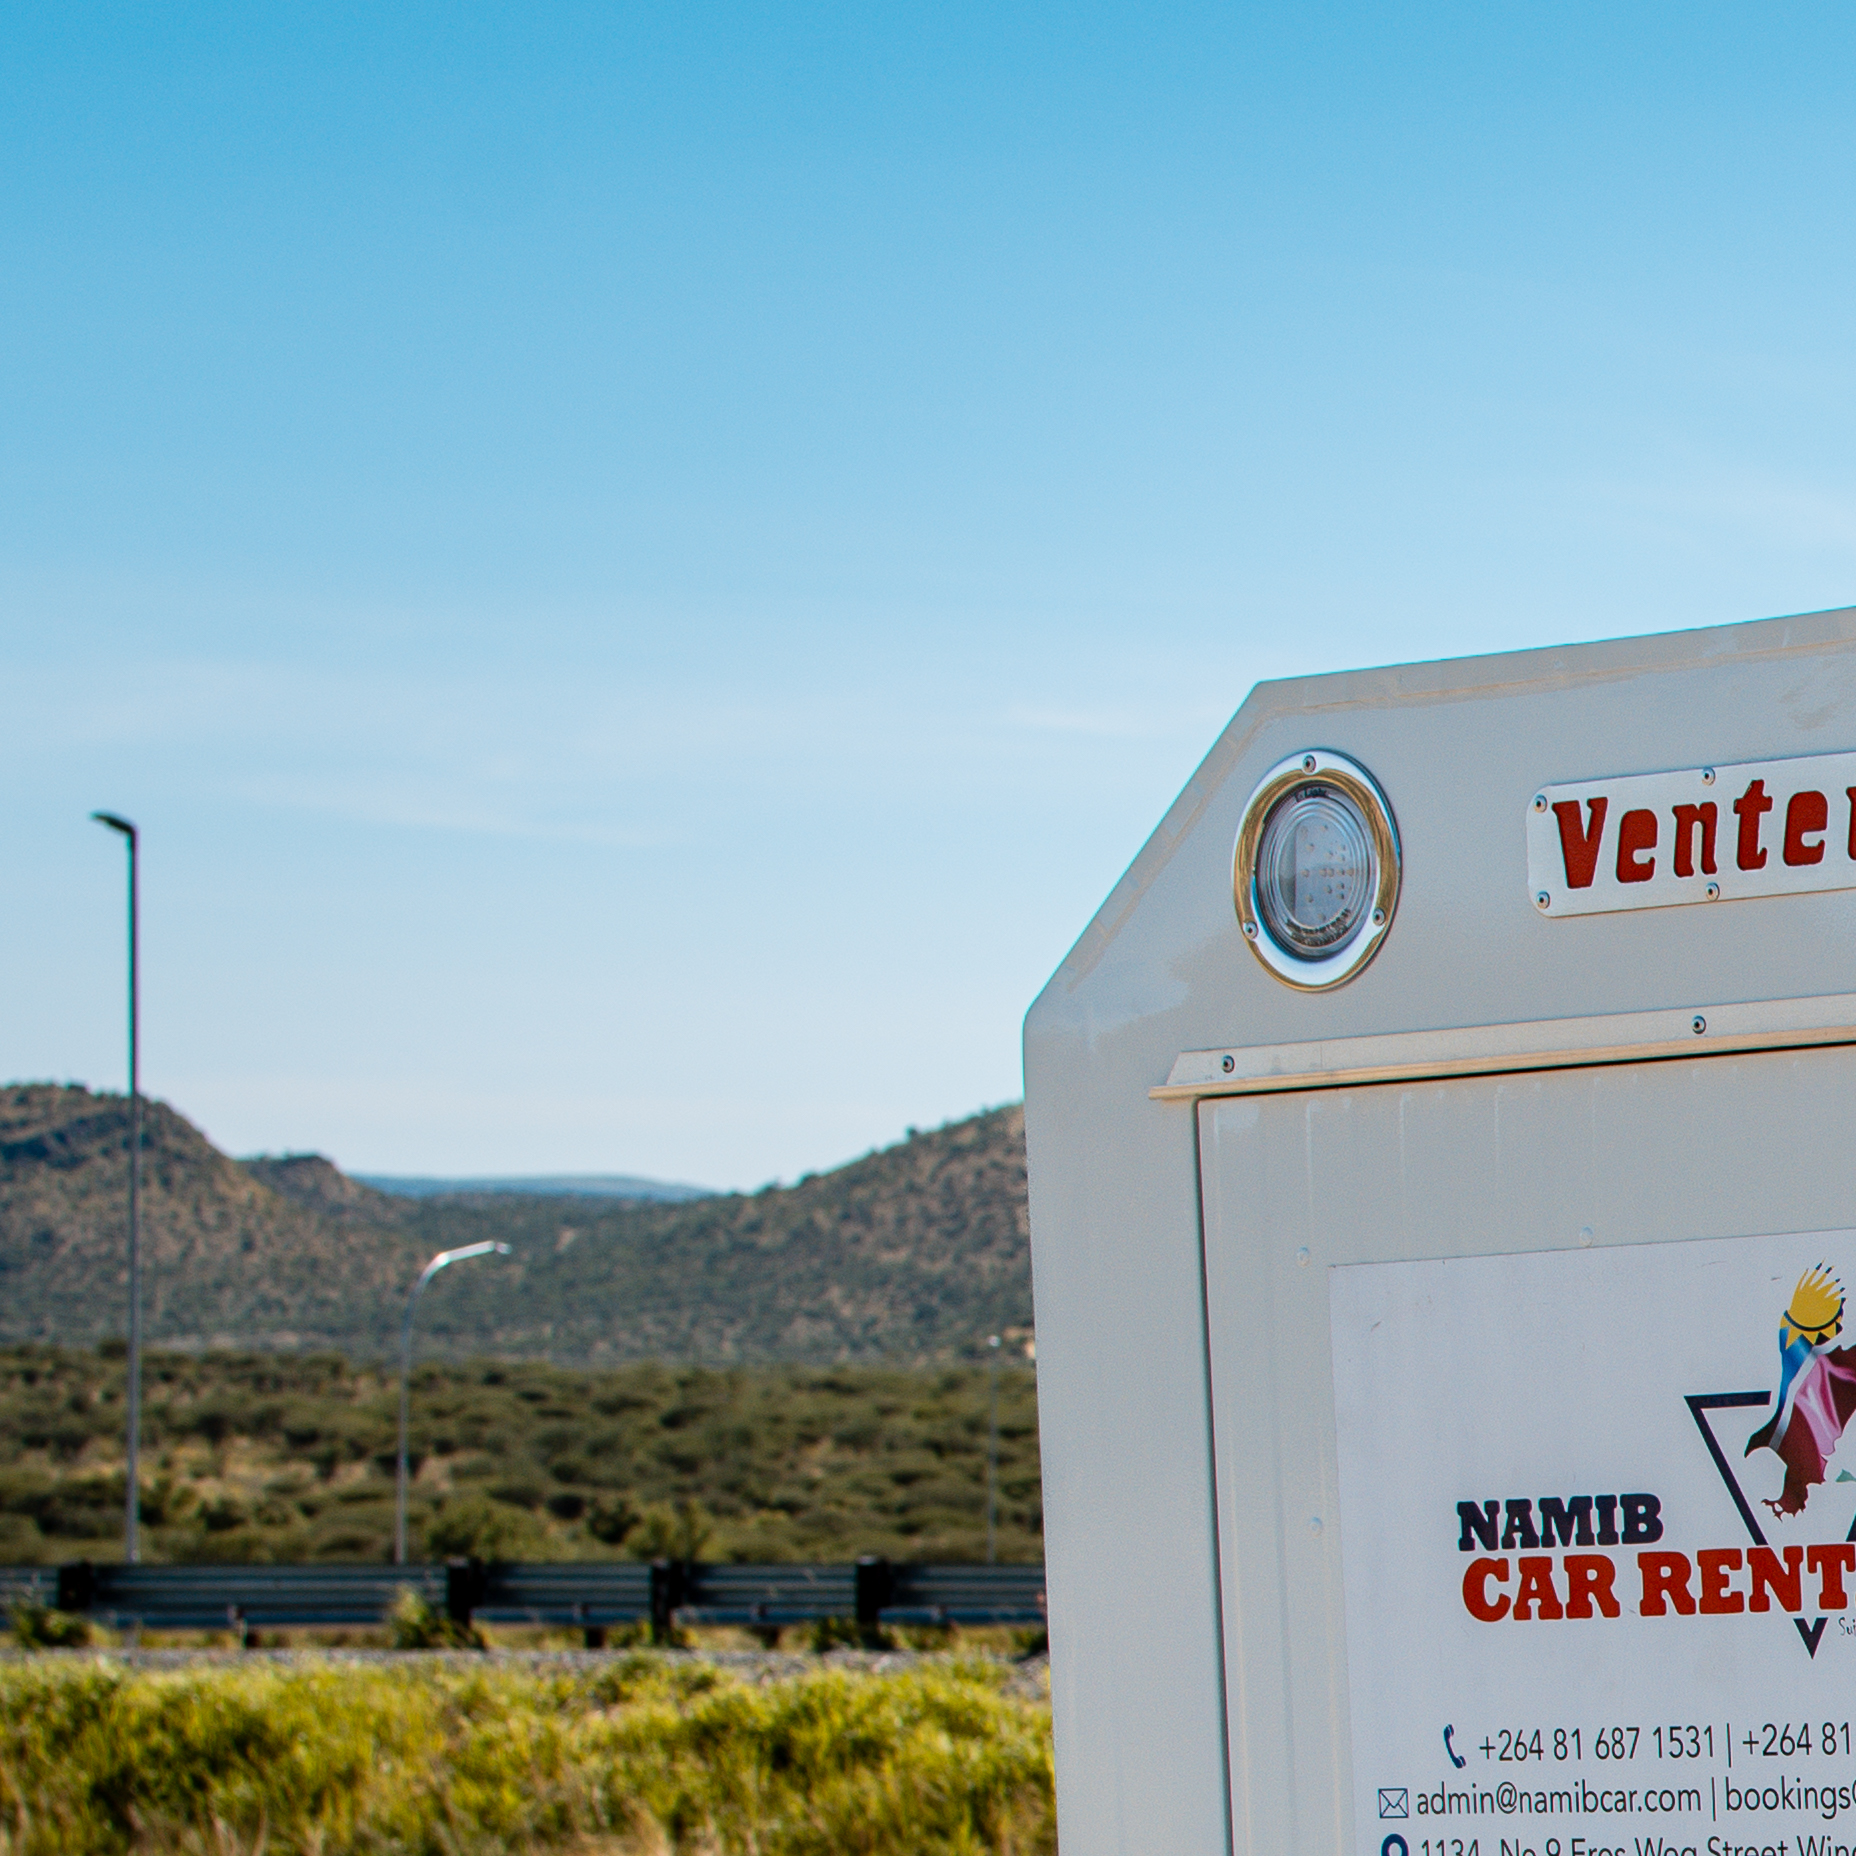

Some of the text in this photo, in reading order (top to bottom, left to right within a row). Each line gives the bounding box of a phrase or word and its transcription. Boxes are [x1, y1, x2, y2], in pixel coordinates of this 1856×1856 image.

[1456, 1493, 1663, 1551] NAMIB
[1462, 1554, 1621, 1622] CAR
[1479, 1728, 1544, 1762] +264
[1553, 1727, 1582, 1761] 81
[1595, 1726, 1640, 1760] 687
[1652, 1725, 1714, 1759] 1531
[1742, 1723, 1812, 1756] +264
[1822, 1721, 1850, 1756] 81
[1417, 1779, 1702, 1815] admin@namibcar.com
